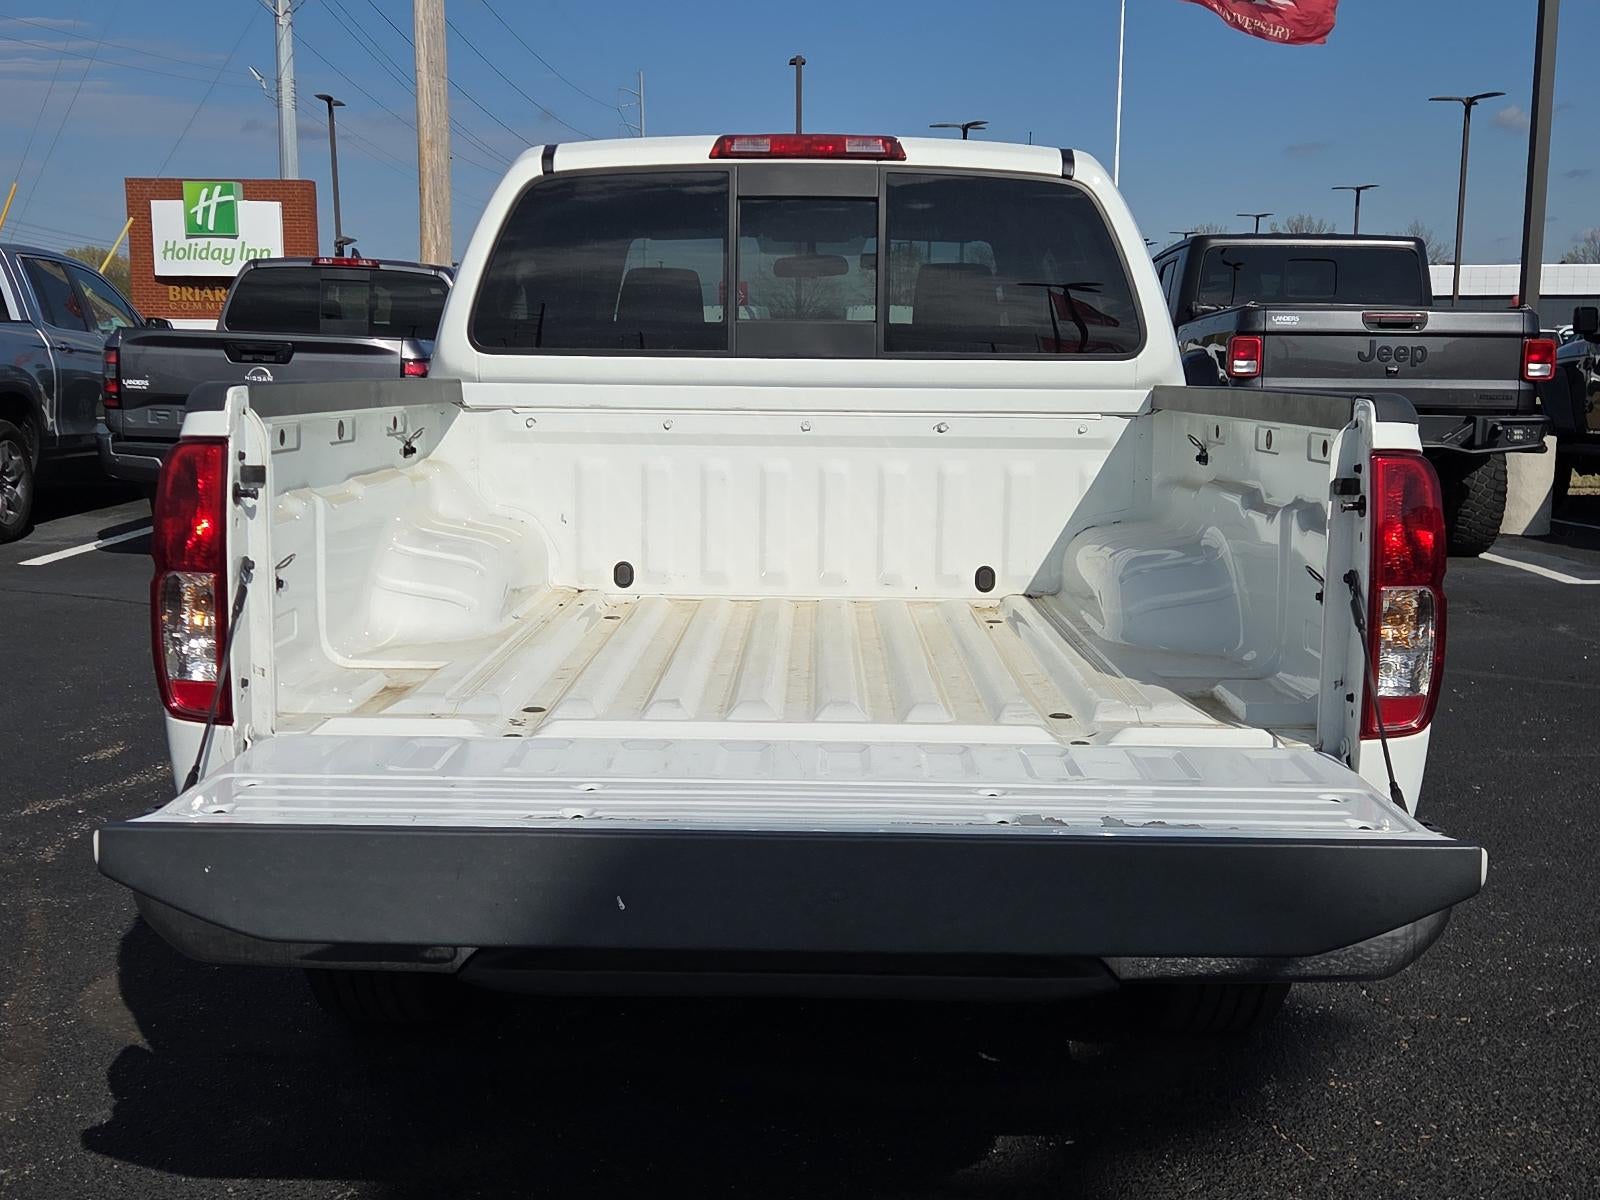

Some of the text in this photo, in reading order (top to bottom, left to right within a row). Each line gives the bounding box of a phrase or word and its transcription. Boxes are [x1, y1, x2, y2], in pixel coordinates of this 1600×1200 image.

[162, 240, 272, 265] Holiday Inn
[168, 286, 230, 302] BRIAR
[1357, 339, 1429, 367] Jeep
